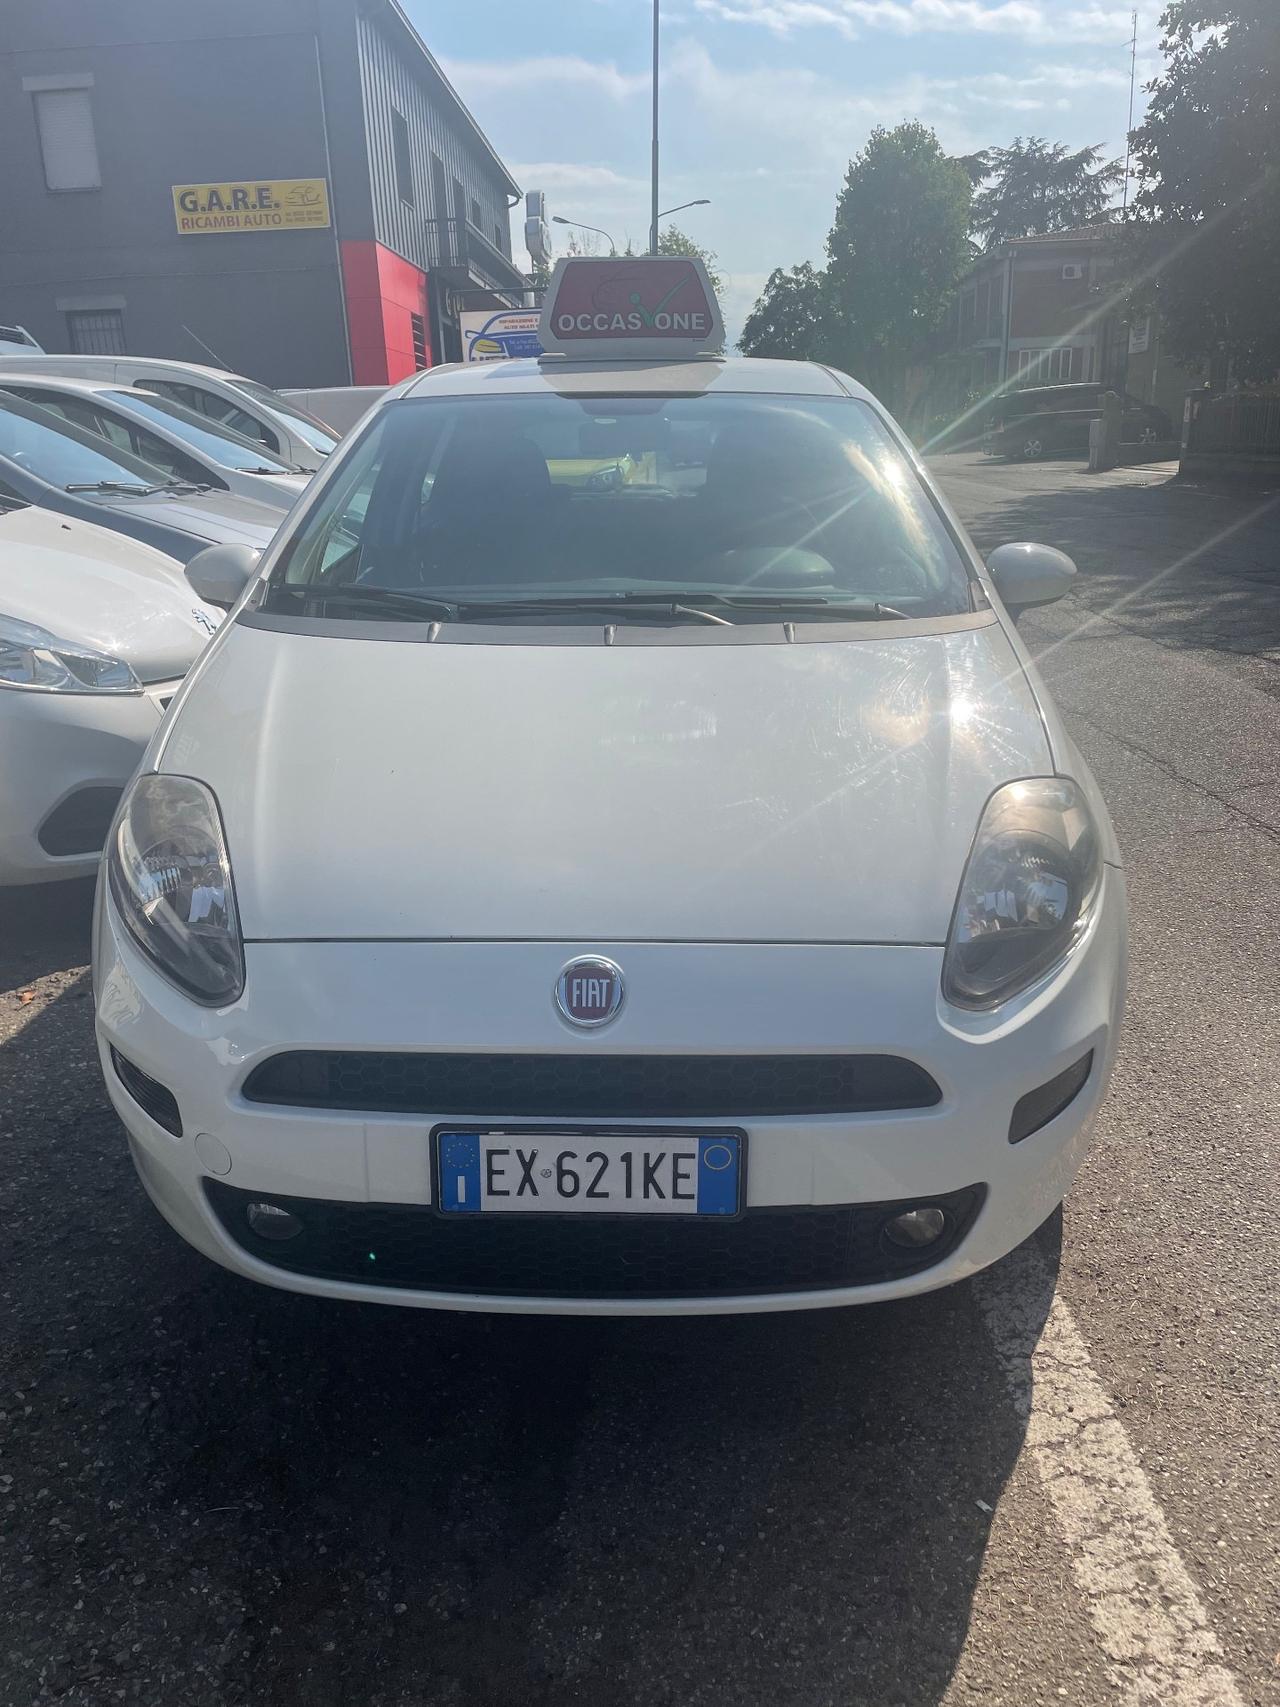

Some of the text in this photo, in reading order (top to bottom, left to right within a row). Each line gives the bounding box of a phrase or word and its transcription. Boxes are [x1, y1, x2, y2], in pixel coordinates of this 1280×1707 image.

[179, 187, 281, 213] G.A.R.E.
[181, 216, 241, 230] RICAMBI
[244, 213, 282, 226] AUTO
[572, 978, 610, 1008] FIAT
[486, 1149, 539, 1197] EX
[556, 1151, 696, 1200] 621KE
